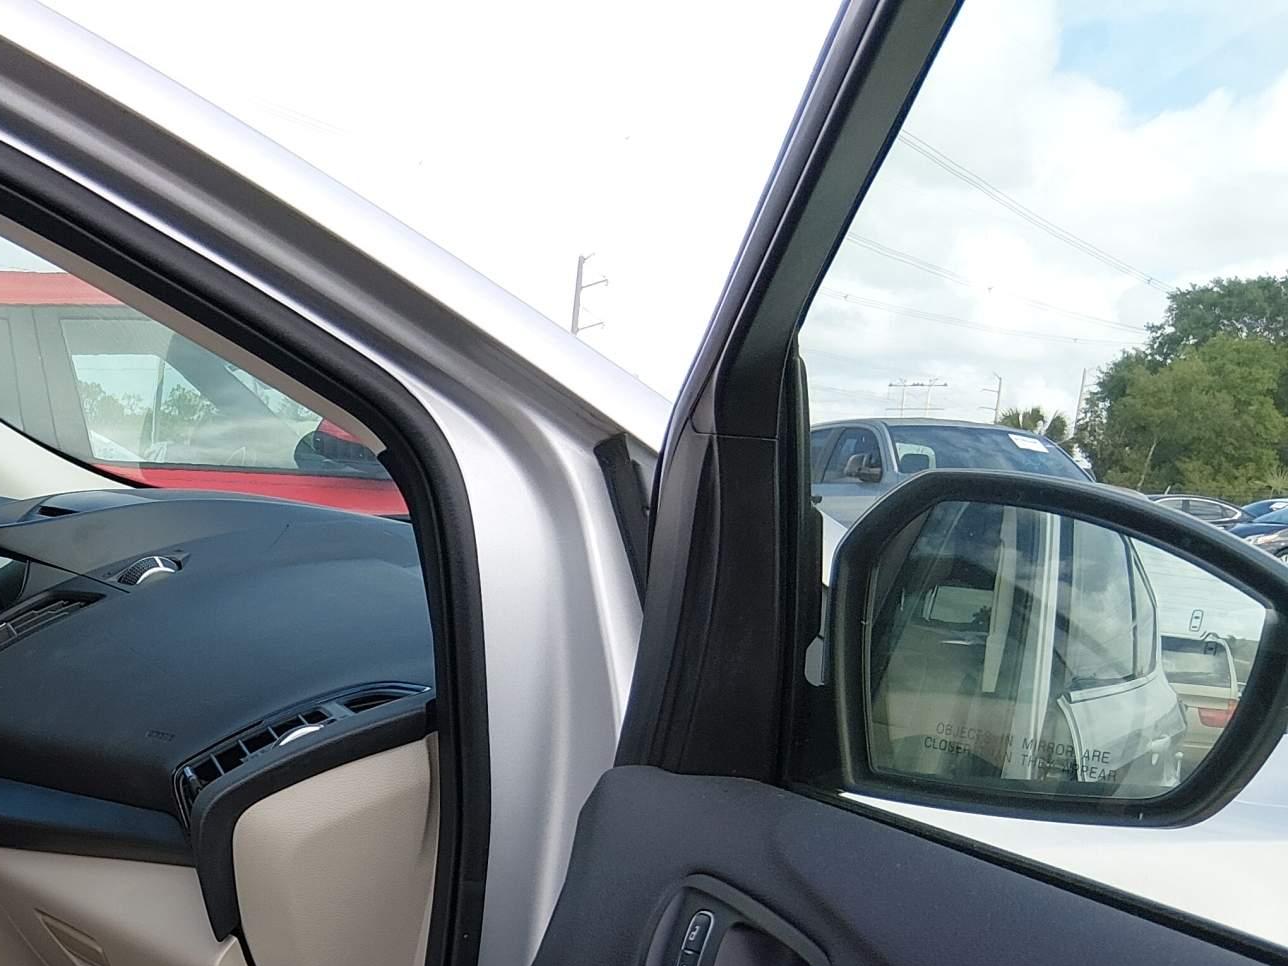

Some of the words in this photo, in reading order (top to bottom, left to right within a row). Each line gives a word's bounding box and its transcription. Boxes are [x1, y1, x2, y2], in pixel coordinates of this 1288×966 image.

[936, 721, 992, 745] OBJECTS
[1022, 737, 1075, 758] MIRROR
[1083, 748, 1112, 765] ARE
